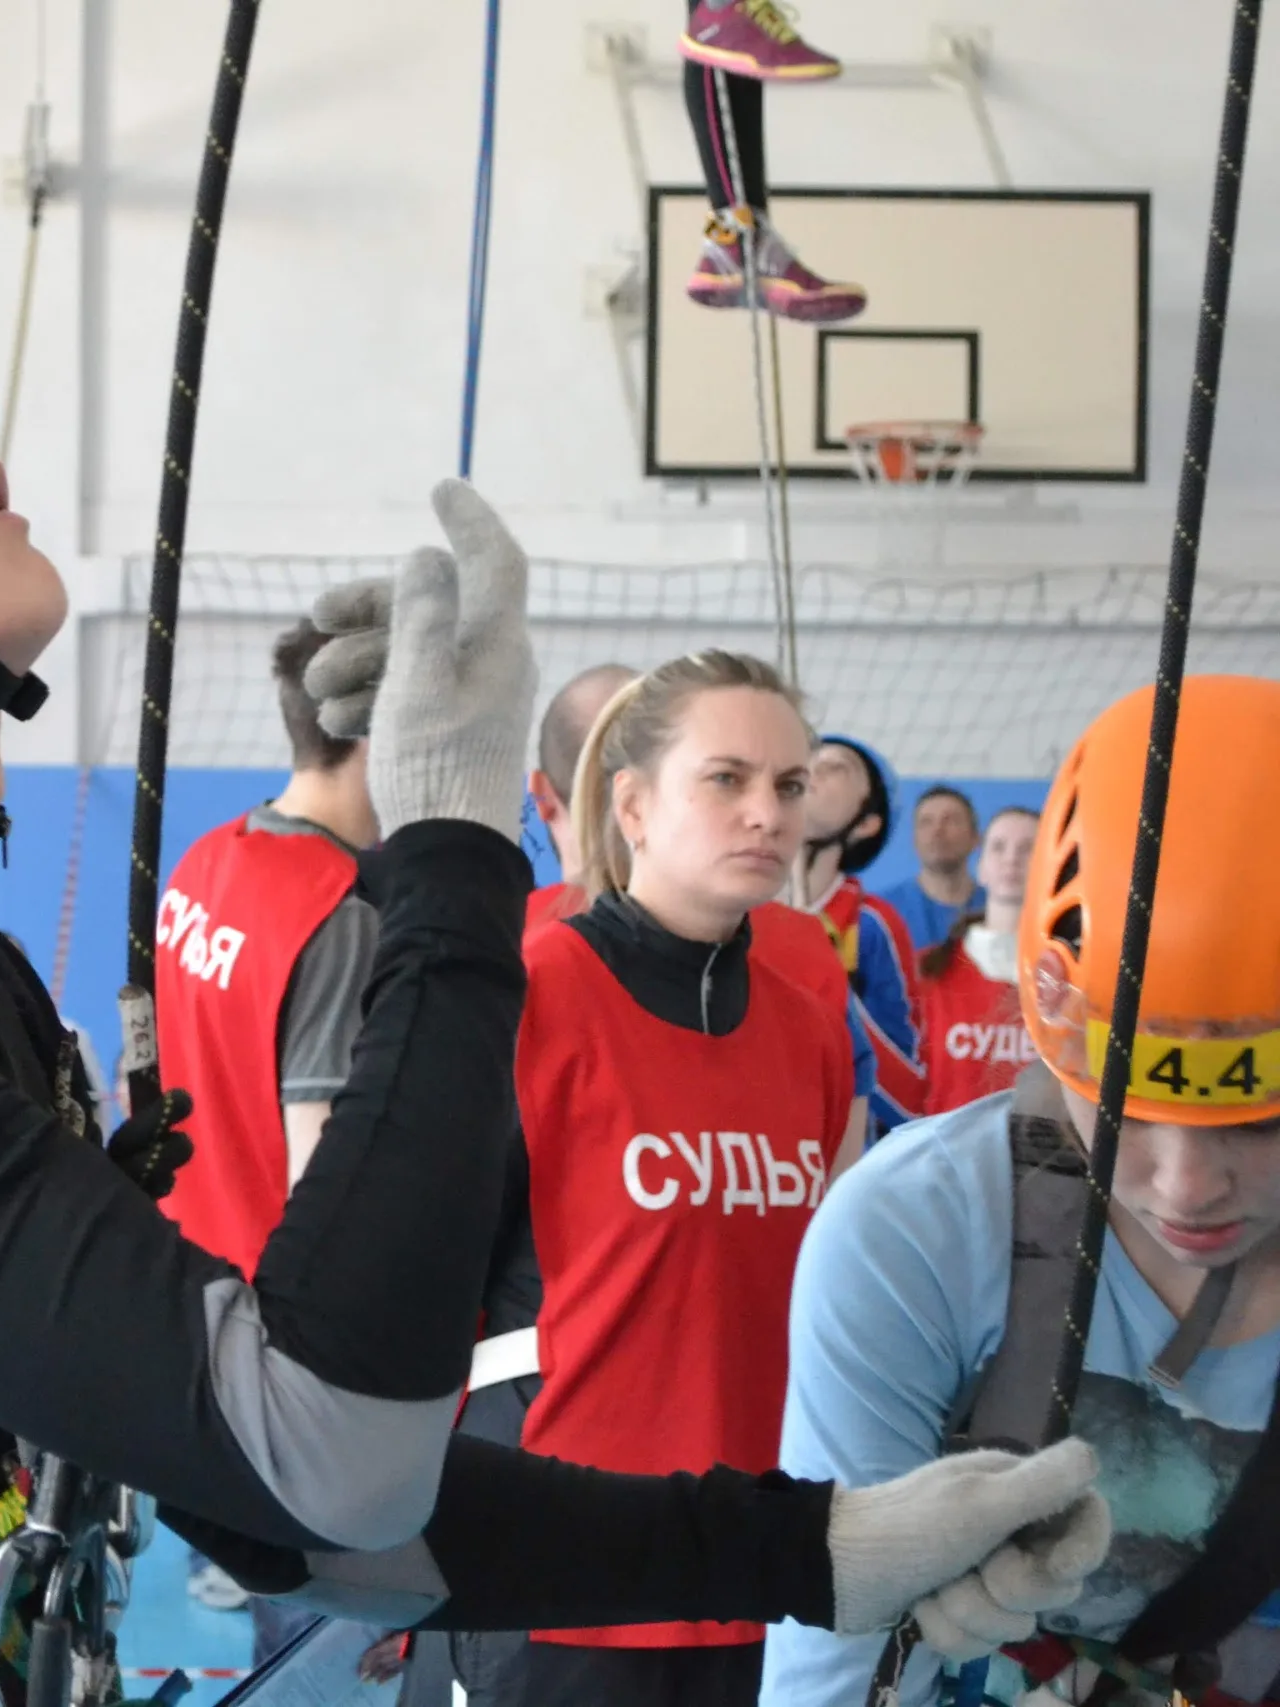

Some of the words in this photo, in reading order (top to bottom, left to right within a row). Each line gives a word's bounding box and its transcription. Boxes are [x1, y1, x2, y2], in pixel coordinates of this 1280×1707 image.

[945, 1022, 1041, 1064] СУДЬ
[1125, 1046, 1262, 1097] 4.4
[623, 1131, 826, 1217] СУДЬЯ
